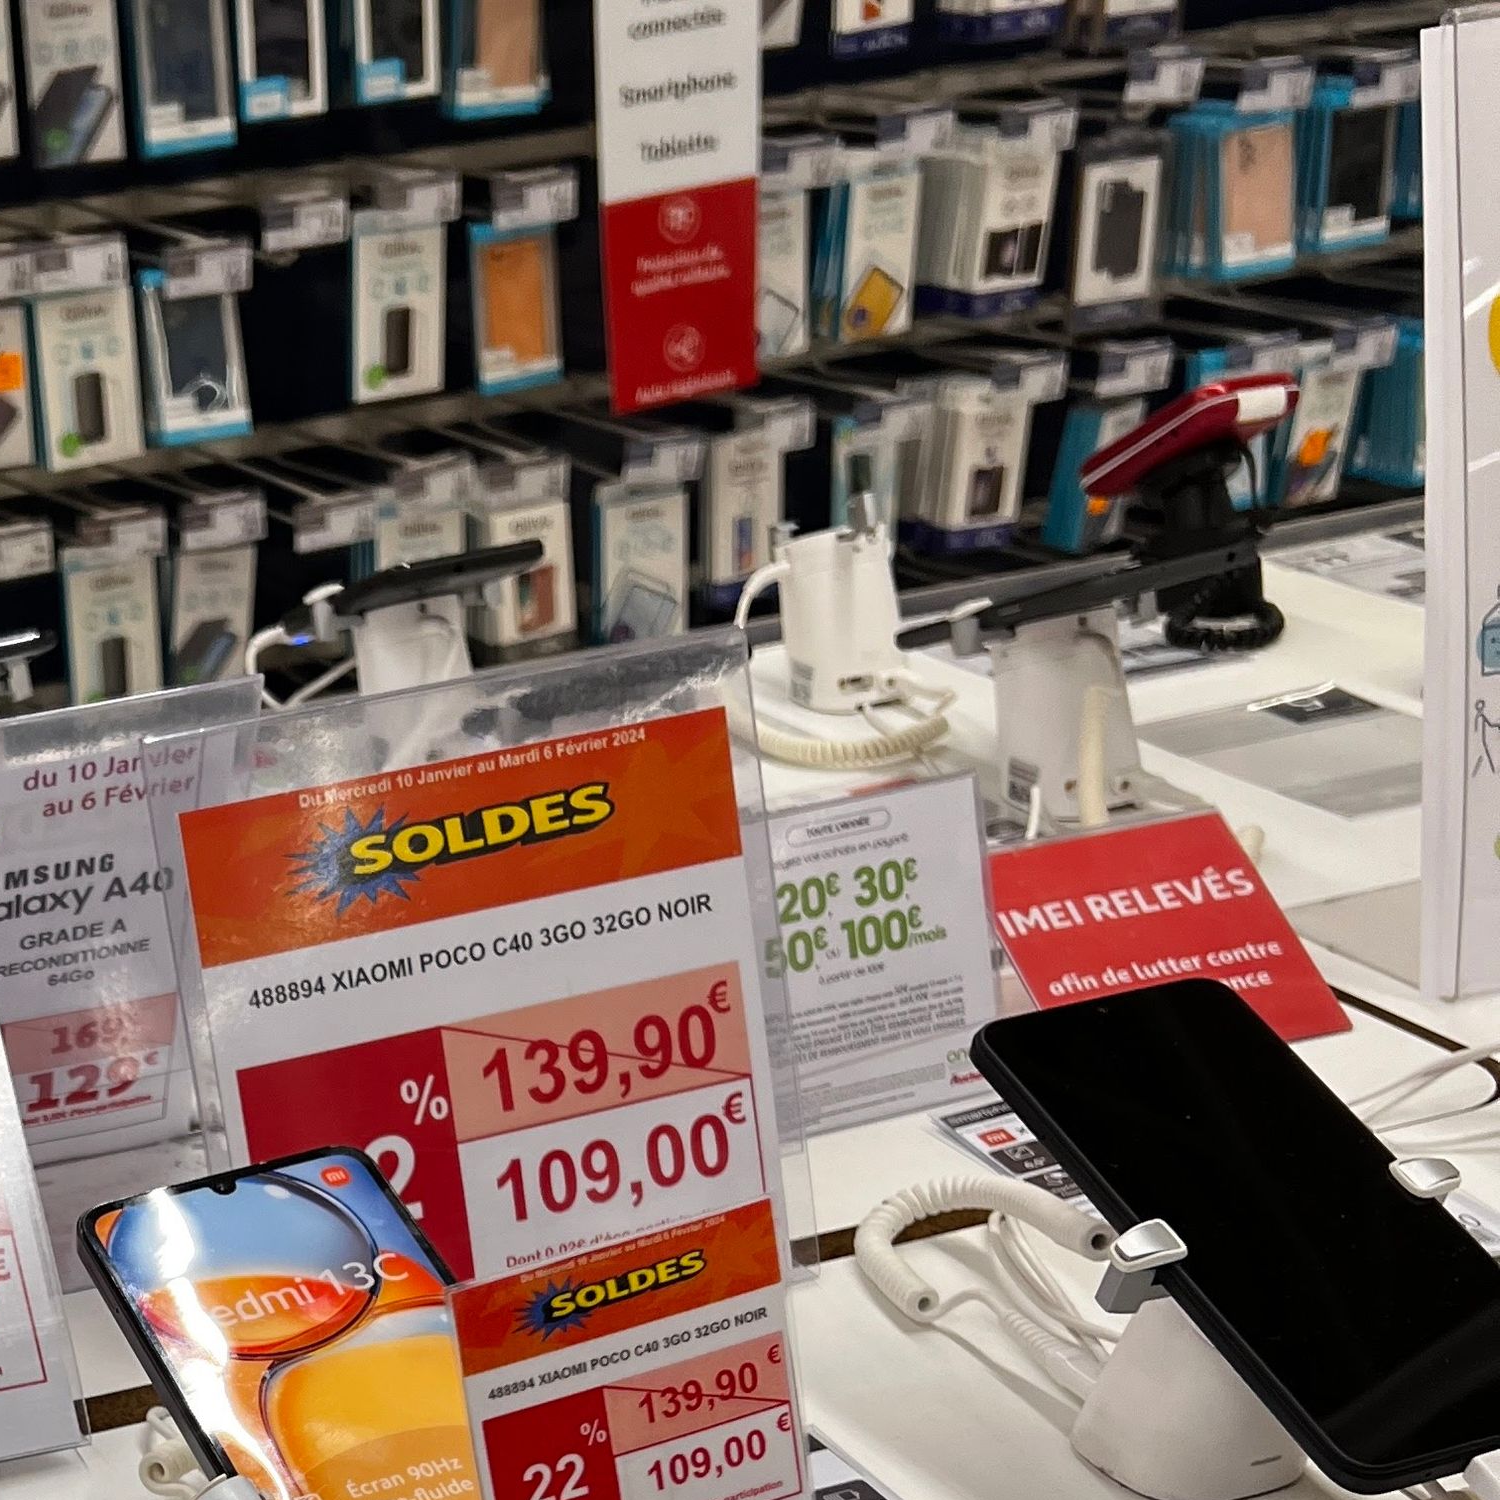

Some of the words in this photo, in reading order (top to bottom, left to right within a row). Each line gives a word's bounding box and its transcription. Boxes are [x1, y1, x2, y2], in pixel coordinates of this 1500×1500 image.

[24, 767, 58, 791] du
[66, 762, 97, 781] 10
[43, 798, 74, 817] au
[80, 791, 96, 811] 6
[352, 784, 612, 874] SOLDES
[997, 902, 1085, 938] IMEI
[1093, 866, 1254, 922] RELEVÉS
[19, 921, 103, 949] GRADE
[109, 919, 127, 934] A
[249, 978, 326, 1009] 488894
[332, 958, 413, 991] XIAOMI
[420, 944, 486, 972] POCO
[492, 933, 533, 956] C40
[541, 921, 587, 946] 3GO
[593, 908, 652, 935] 32GO
[658, 894, 712, 921] NOIR
[1048, 965, 1097, 997] afin
[1102, 966, 1128, 986] de
[1132, 953, 1202, 982] lutter
[1206, 940, 1282, 967] contre
[401, 1076, 449, 1125] %
[215, 1275, 313, 1327] edmi
[320, 1252, 407, 1304] 13C
[551, 1250, 705, 1317] SOLDES
[488, 1378, 535, 1400] 488894
[539, 1361, 588, 1386] XIAOMI
[591, 1350, 631, 1370] POCO
[634, 1340, 659, 1359] C40
[663, 1332, 691, 1350] 3GO
[695, 1321, 731, 1341] 32GO
[734, 1307, 768, 1328] NOIR
[638, 1362, 758, 1424] 139,90
[346, 1472, 405, 1500] Écran
[408, 1456, 462, 1484] 90Hz
[648, 1429, 766, 1492] 109,00
